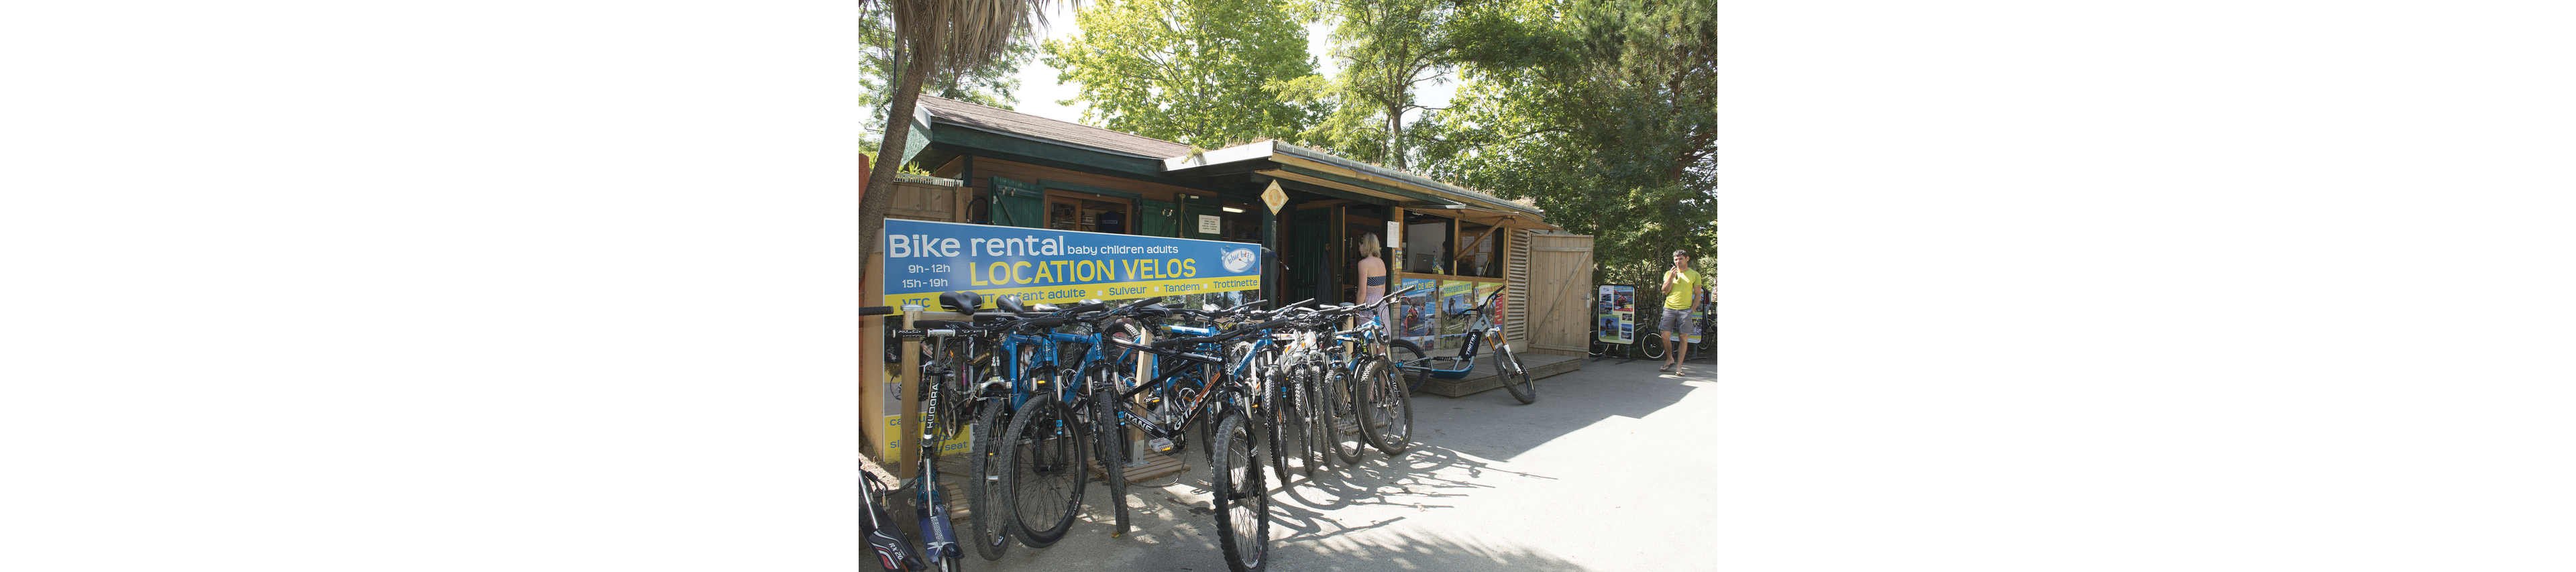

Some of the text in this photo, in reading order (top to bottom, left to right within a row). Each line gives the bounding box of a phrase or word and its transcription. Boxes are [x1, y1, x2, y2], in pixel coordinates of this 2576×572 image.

[889, 234, 1179, 258] Bike rental baby children adults
[969, 258, 1196, 286] LOCATION VELOS
[1048, 288, 1086, 299] adulte
[1164, 283, 1200, 293] Tandem
[1213, 278, 1258, 289] Trottinette
[926, 383, 939, 428] HUDORA
[1124, 412, 1154, 433] ITANE
[945, 441, 968, 451] seat
